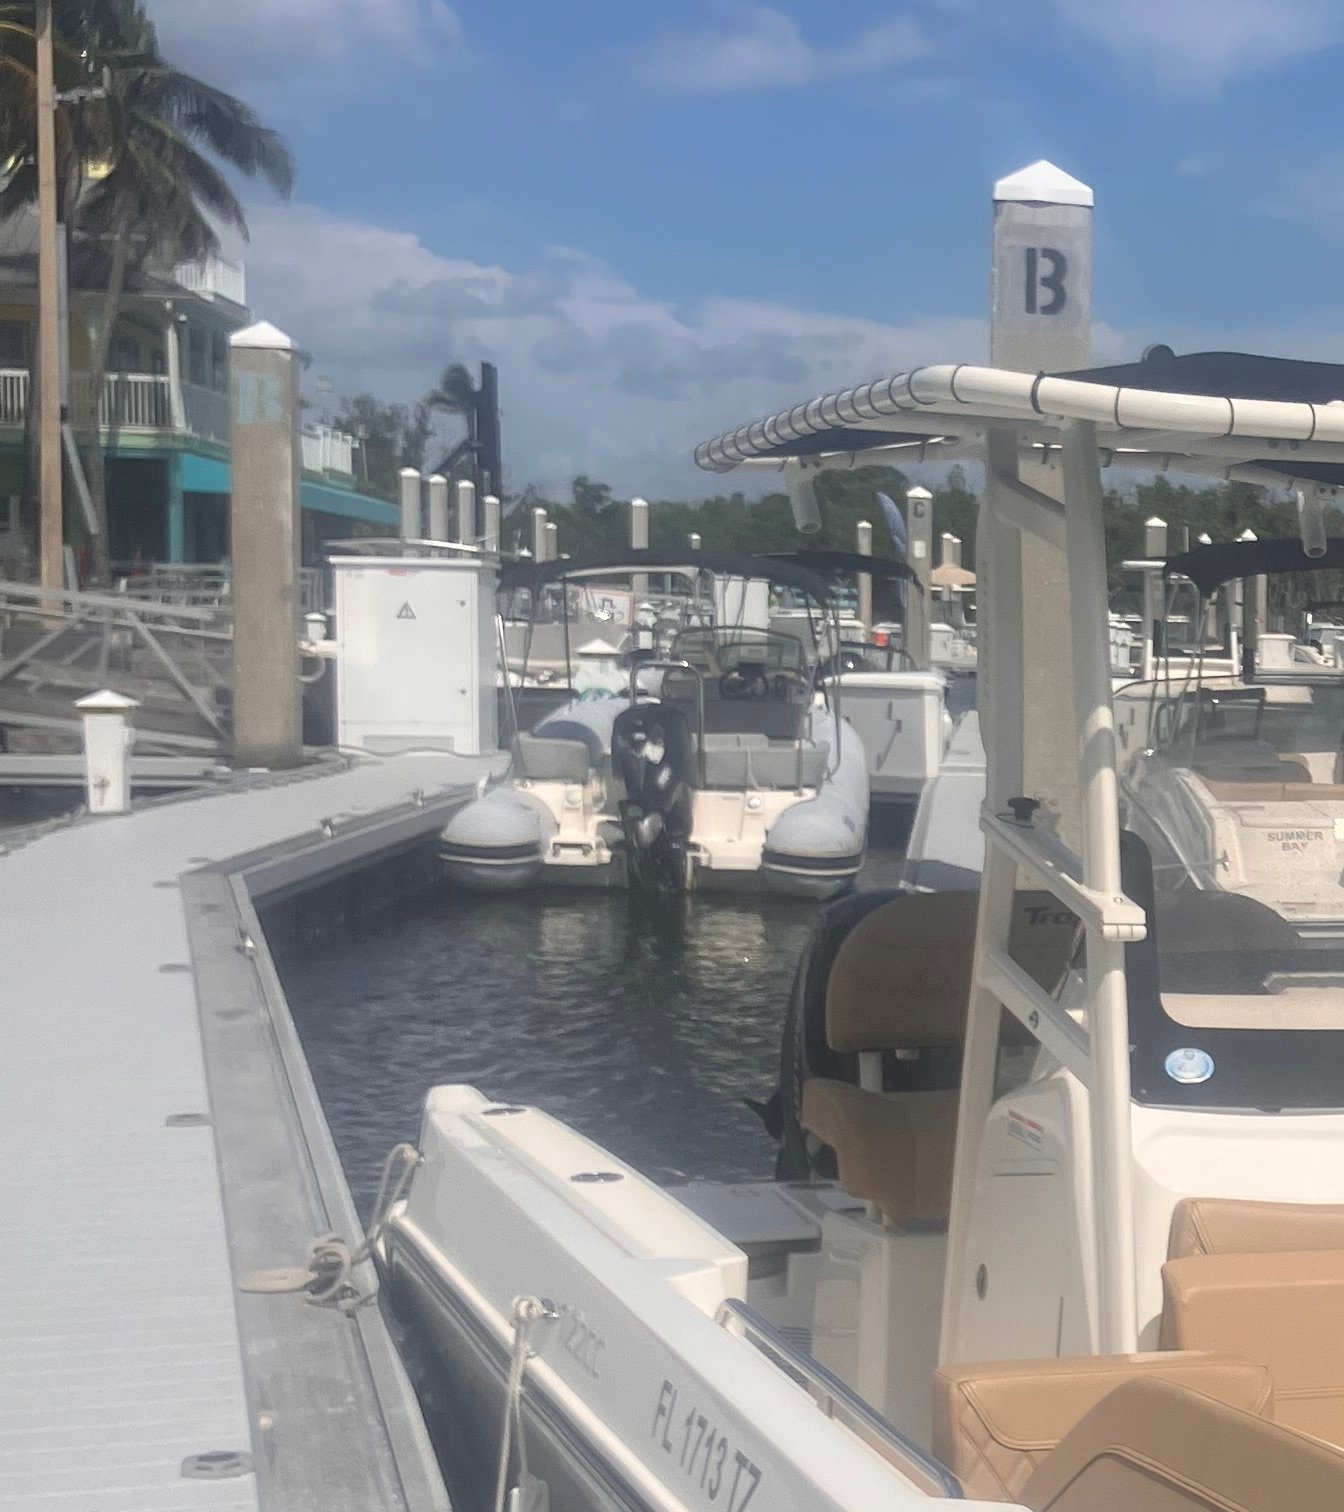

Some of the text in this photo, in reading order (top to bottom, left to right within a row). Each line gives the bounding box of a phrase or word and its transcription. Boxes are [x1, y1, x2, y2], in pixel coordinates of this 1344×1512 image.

[1025, 247, 1067, 316] B
[912, 501, 926, 518] C
[1267, 831, 1323, 841] SUMMER
[1282, 841, 1309, 852] BAY
[652, 1379, 678, 1453] FL
[680, 1406, 728, 1501] 1713
